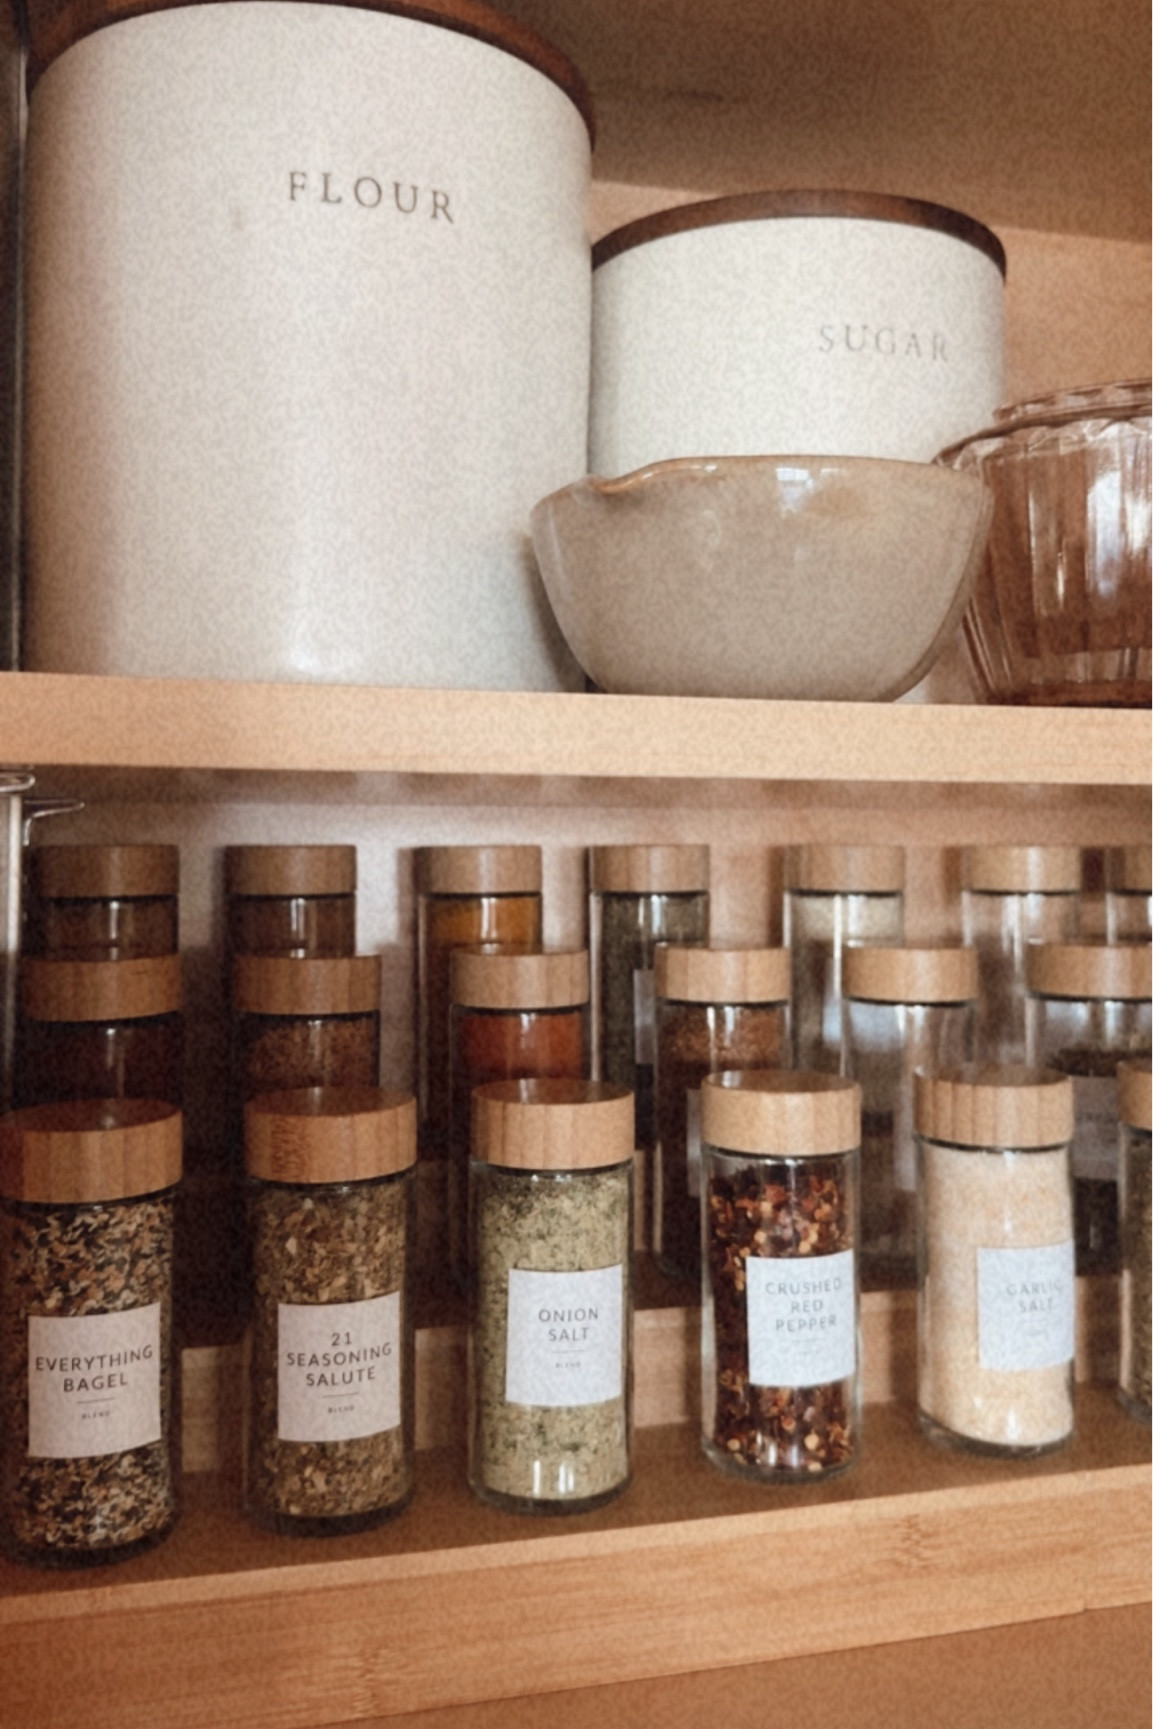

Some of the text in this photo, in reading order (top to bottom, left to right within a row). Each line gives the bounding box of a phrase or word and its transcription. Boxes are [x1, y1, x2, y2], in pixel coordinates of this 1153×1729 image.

[289, 171, 453, 224] FLOUR
[819, 324, 948, 362] SUGAR
[765, 1277, 841, 1295] CRUSHED
[1006, 1280, 1062, 1296] GARLIC
[791, 1299, 823, 1313] RED
[1019, 1298, 1053, 1313] SALT
[538, 1307, 598, 1322] ONION
[776, 1315, 837, 1332] PEPPER
[331, 1332, 352, 1346] 21
[548, 1327, 589, 1341] SALT
[35, 1344, 153, 1372] EVERYTHING
[286, 1342, 392, 1367] SEASONING
[63, 1372, 128, 1393] BAGEL
[306, 1366, 376, 1387] SALUTE
